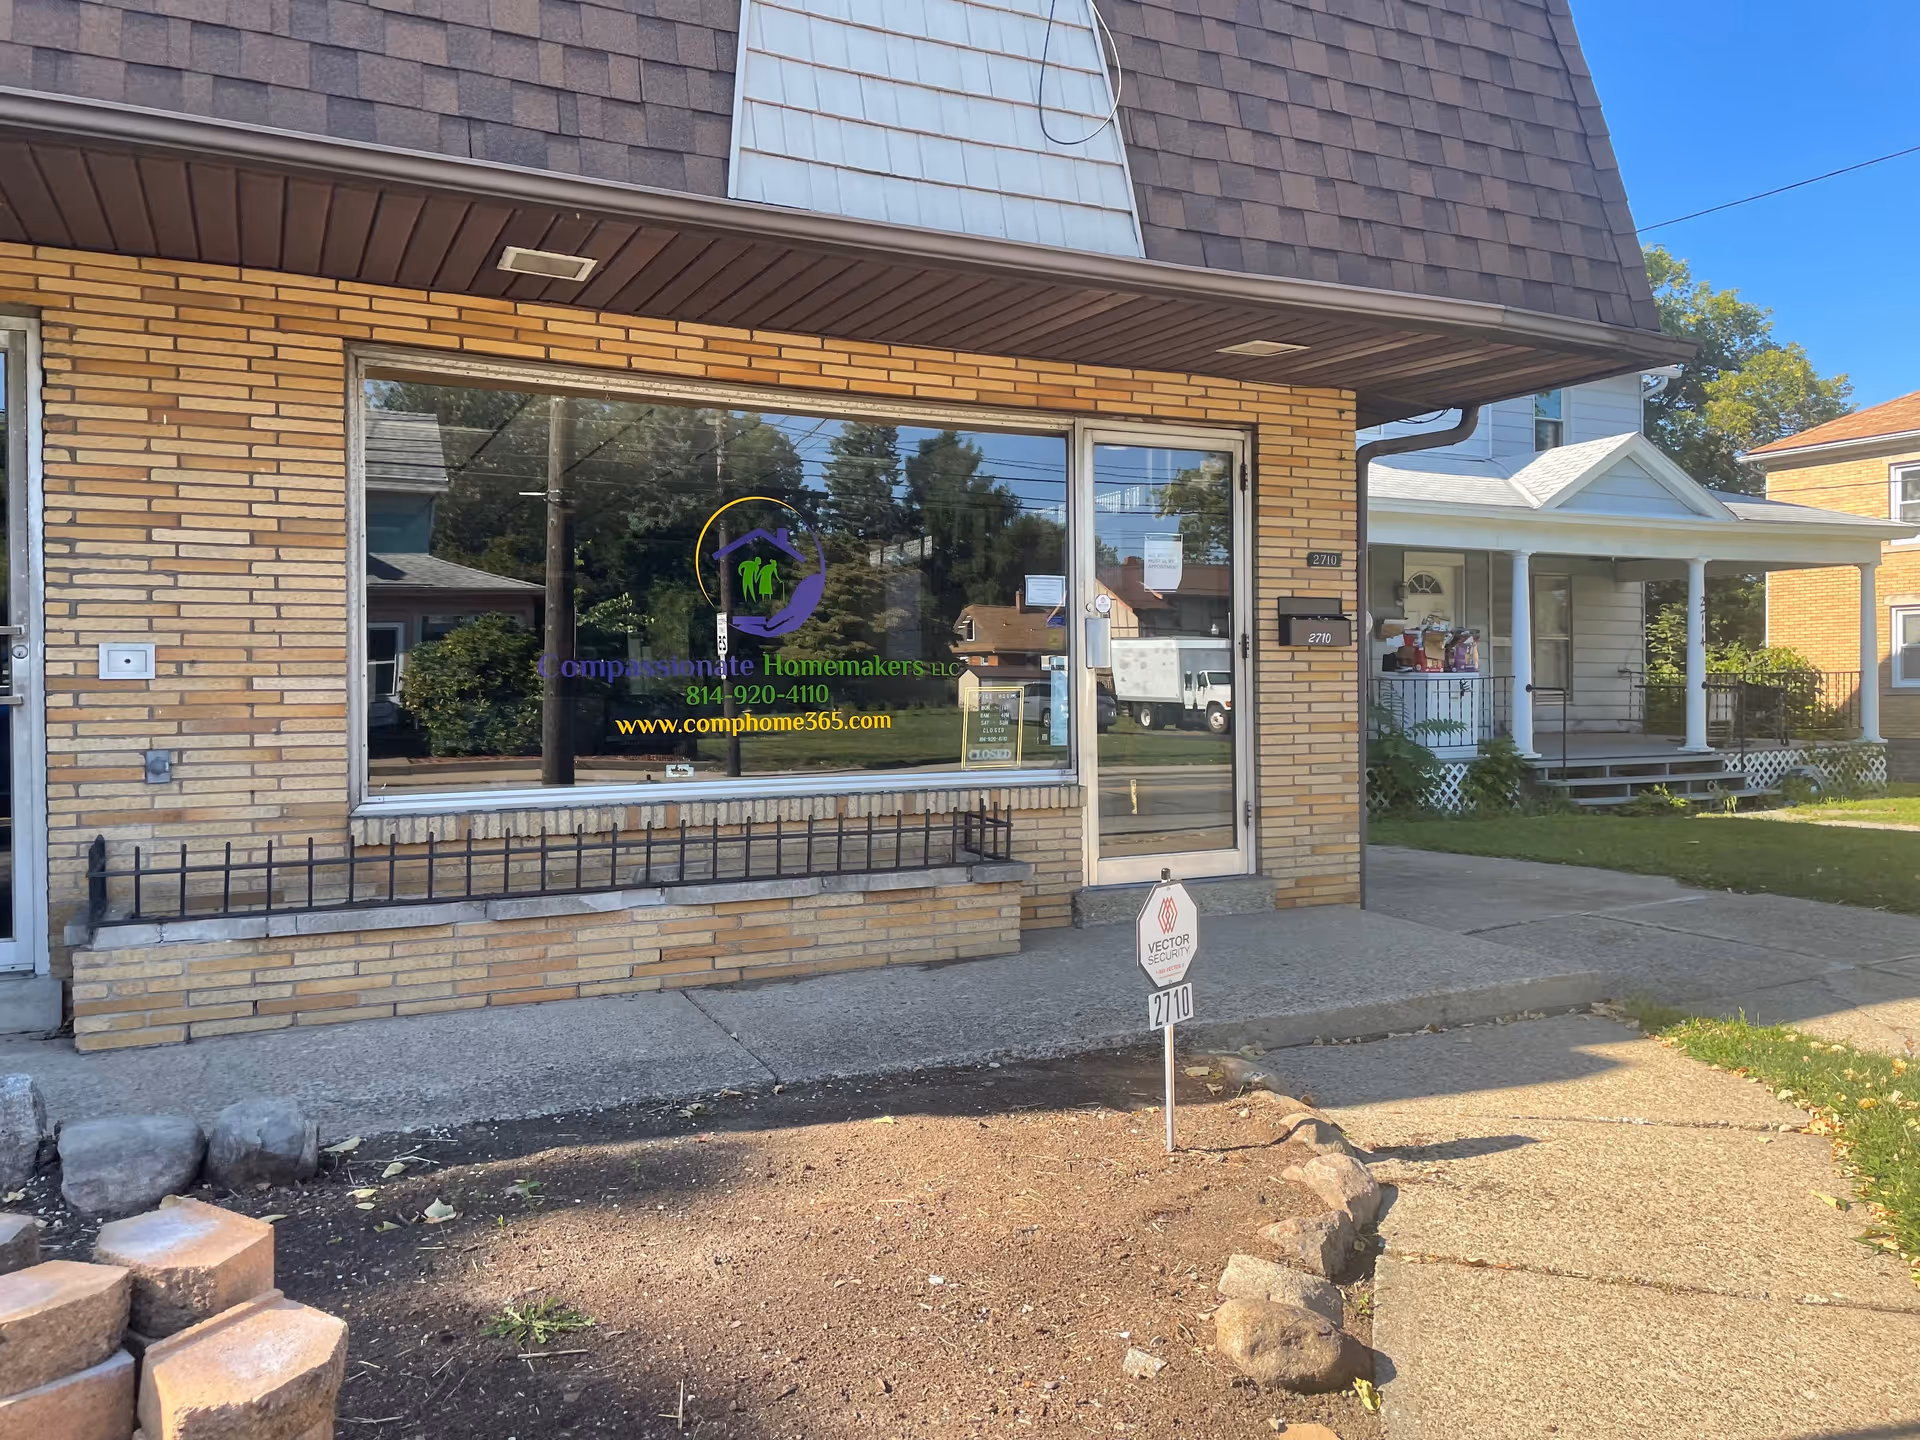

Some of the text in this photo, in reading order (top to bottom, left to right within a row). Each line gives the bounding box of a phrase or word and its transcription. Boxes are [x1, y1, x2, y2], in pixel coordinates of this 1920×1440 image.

[1312, 554, 1337, 566] 2710
[1308, 632, 1332, 644] 2710
[537, 652, 960, 684] Compassionate Homemakers LLC
[686, 684, 829, 705] 814-920-4110
[615, 711, 892, 737] www.comphome365.com
[1148, 933, 1190, 954] VECTOR
[1148, 946, 1190, 966] SECURITY
[1154, 986, 1190, 1026] 2710
